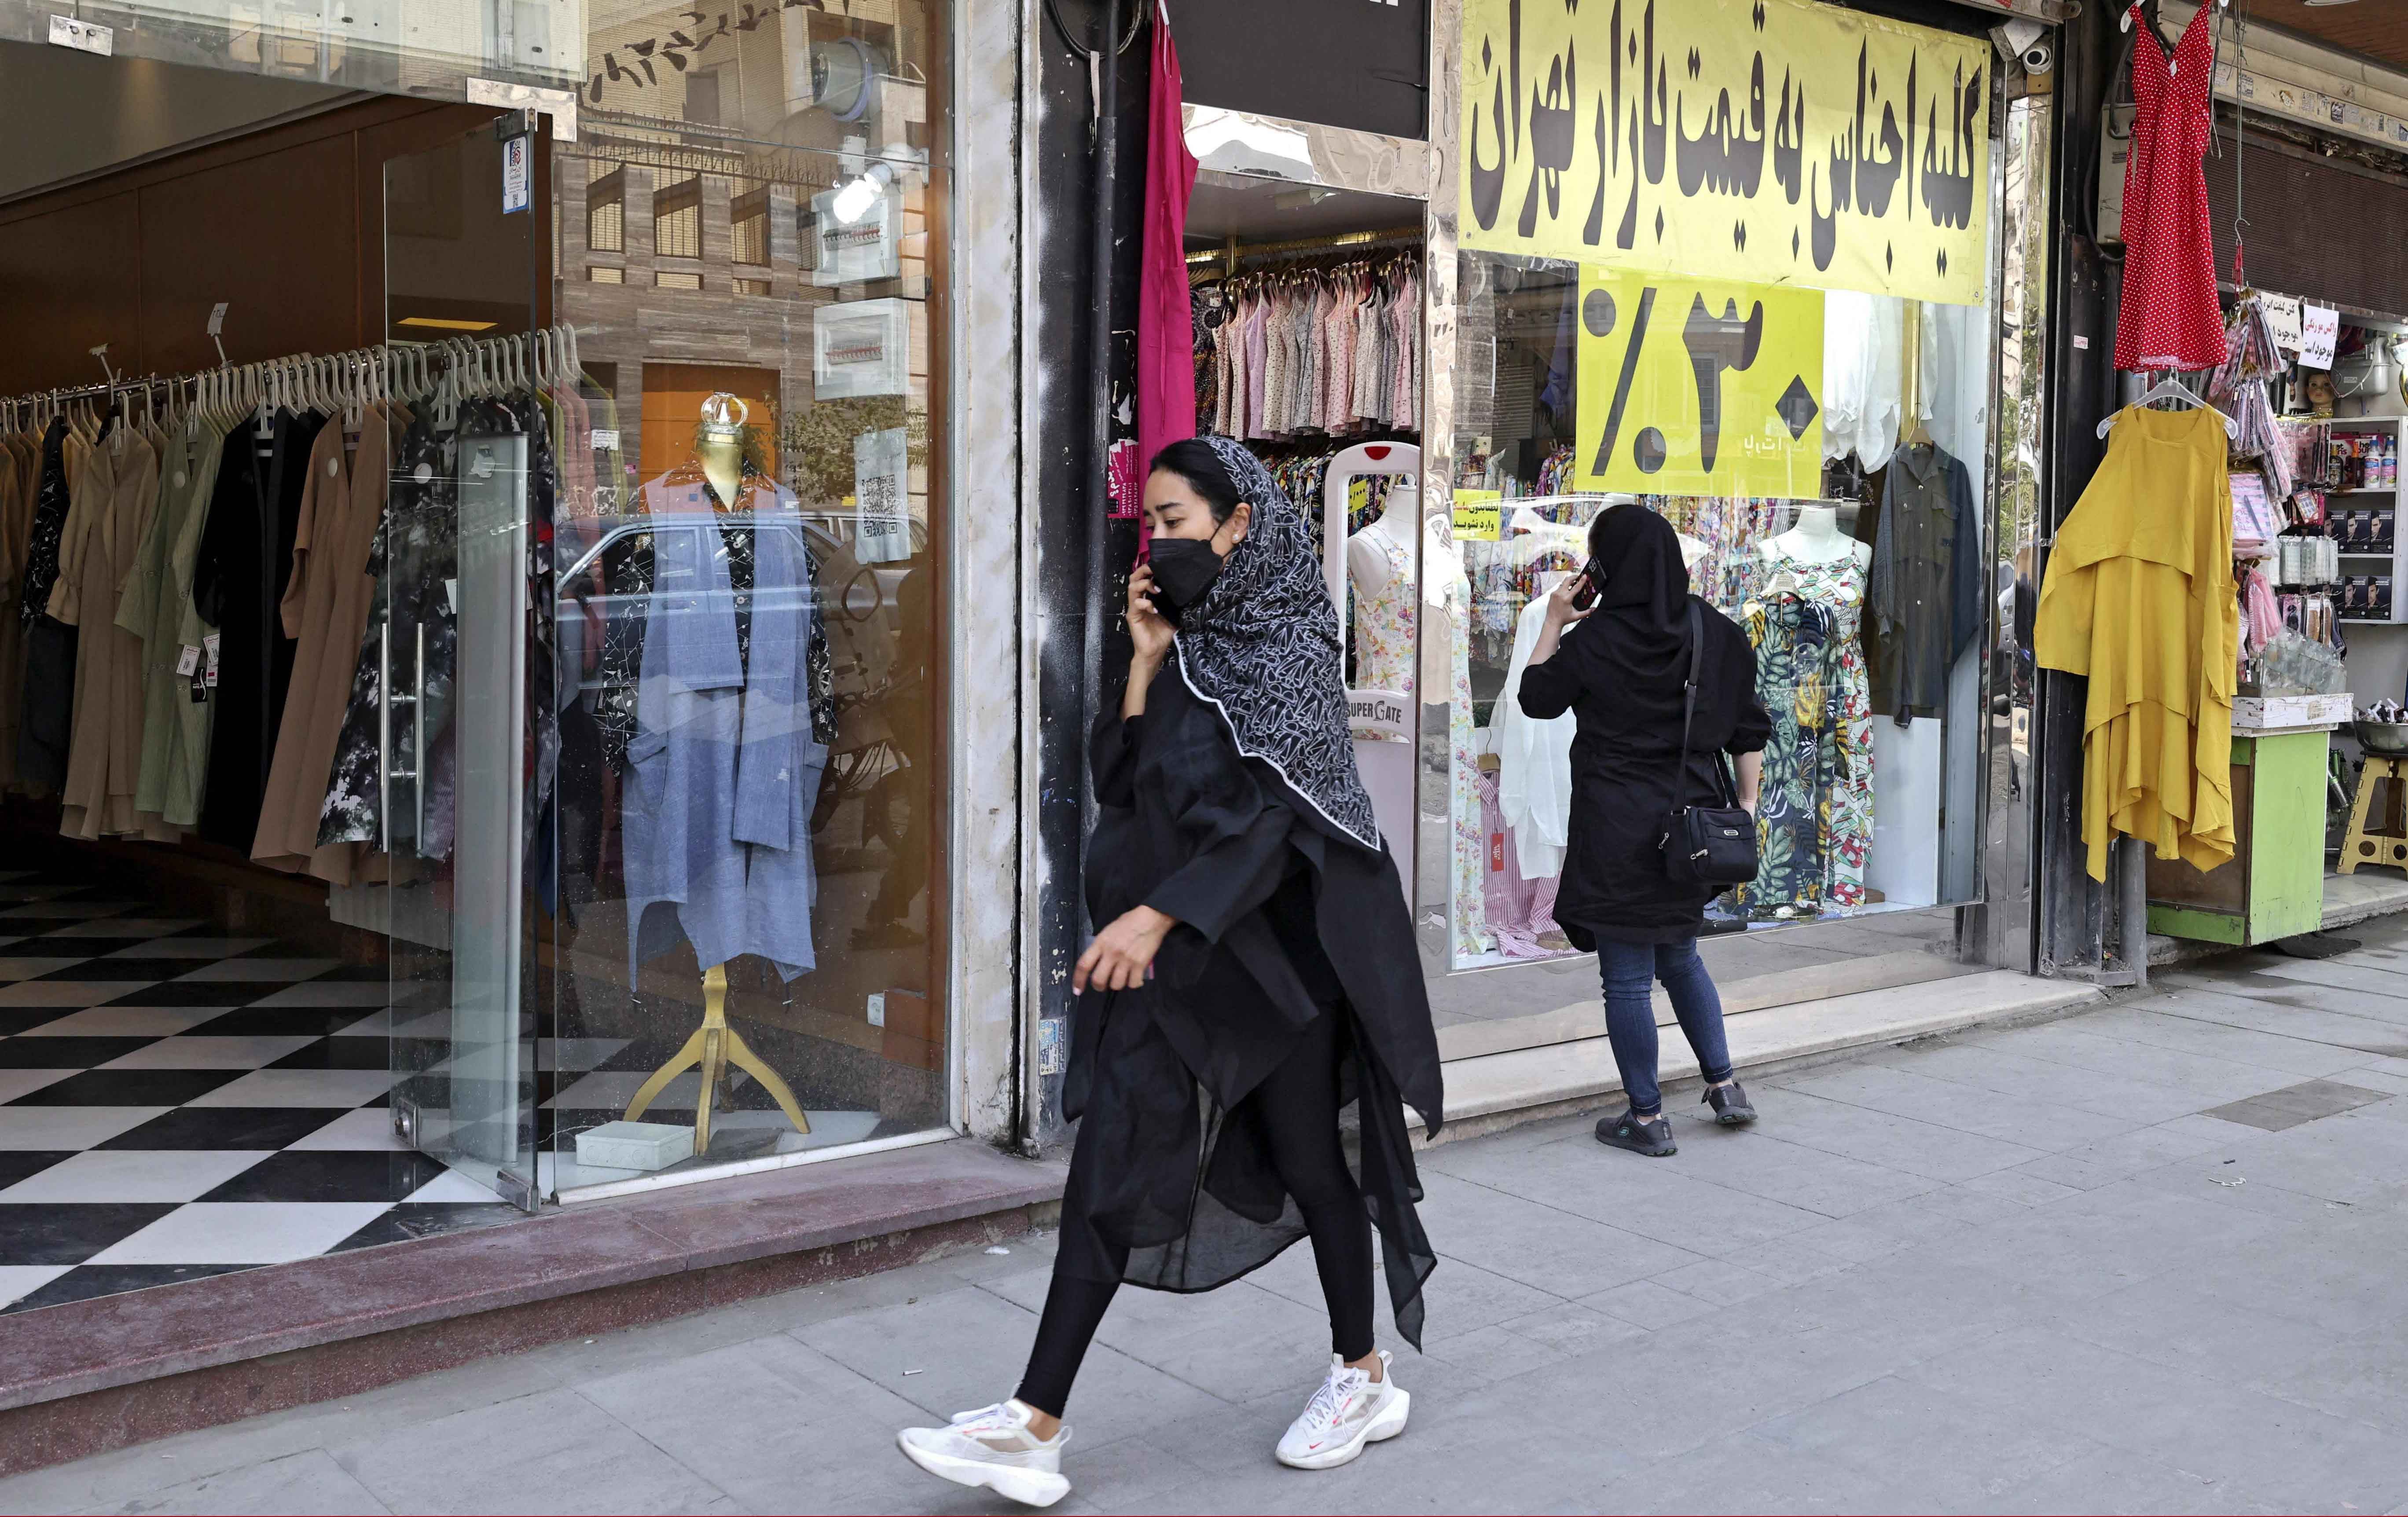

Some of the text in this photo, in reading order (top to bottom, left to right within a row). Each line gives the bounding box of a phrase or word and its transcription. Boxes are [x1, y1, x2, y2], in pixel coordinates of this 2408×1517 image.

[1470, 0, 1982, 277] کلیه اجناس به قیمت بازار تهران
[2314, 344, 2333, 362] موجود
[1454, 518, 1494, 532] وارد نشوید
